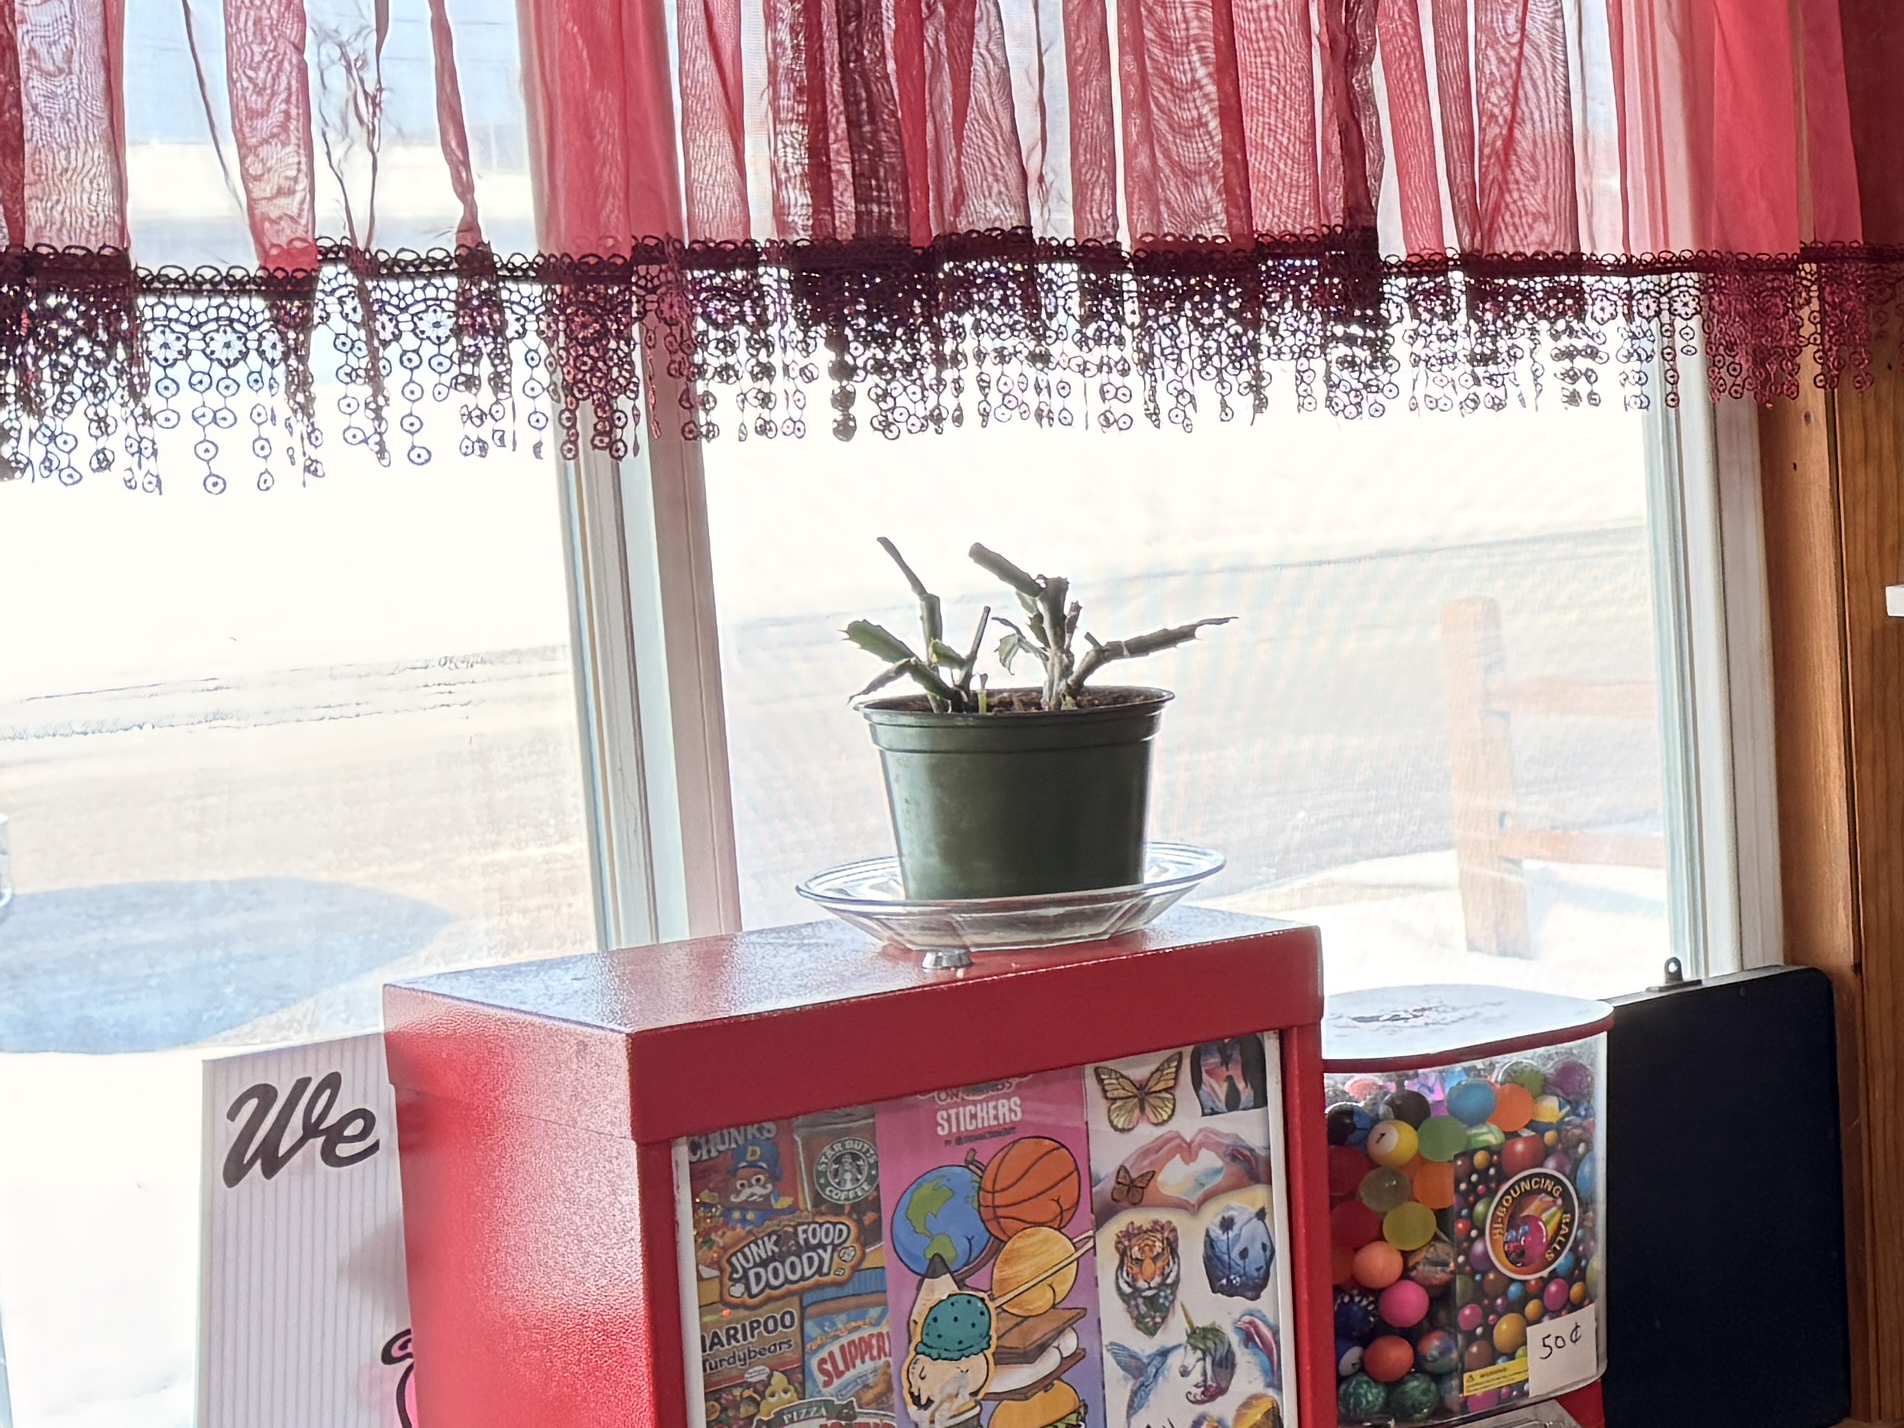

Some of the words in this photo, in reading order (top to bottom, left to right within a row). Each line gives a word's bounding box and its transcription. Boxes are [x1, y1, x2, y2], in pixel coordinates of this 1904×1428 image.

[223, 1070, 381, 1189] We
[936, 1097, 1022, 1135] STICKERS
[825, 1181, 872, 1201] COFFEE
[729, 1234, 780, 1279] JUNK
[797, 1222, 850, 1247] FOOD
[1545, 1213, 1571, 1262] BALLS
[748, 1245, 834, 1296] DOODY
[1539, 1320, 1576, 1353] 50¢
[783, 1406, 827, 1424] PIZZA
